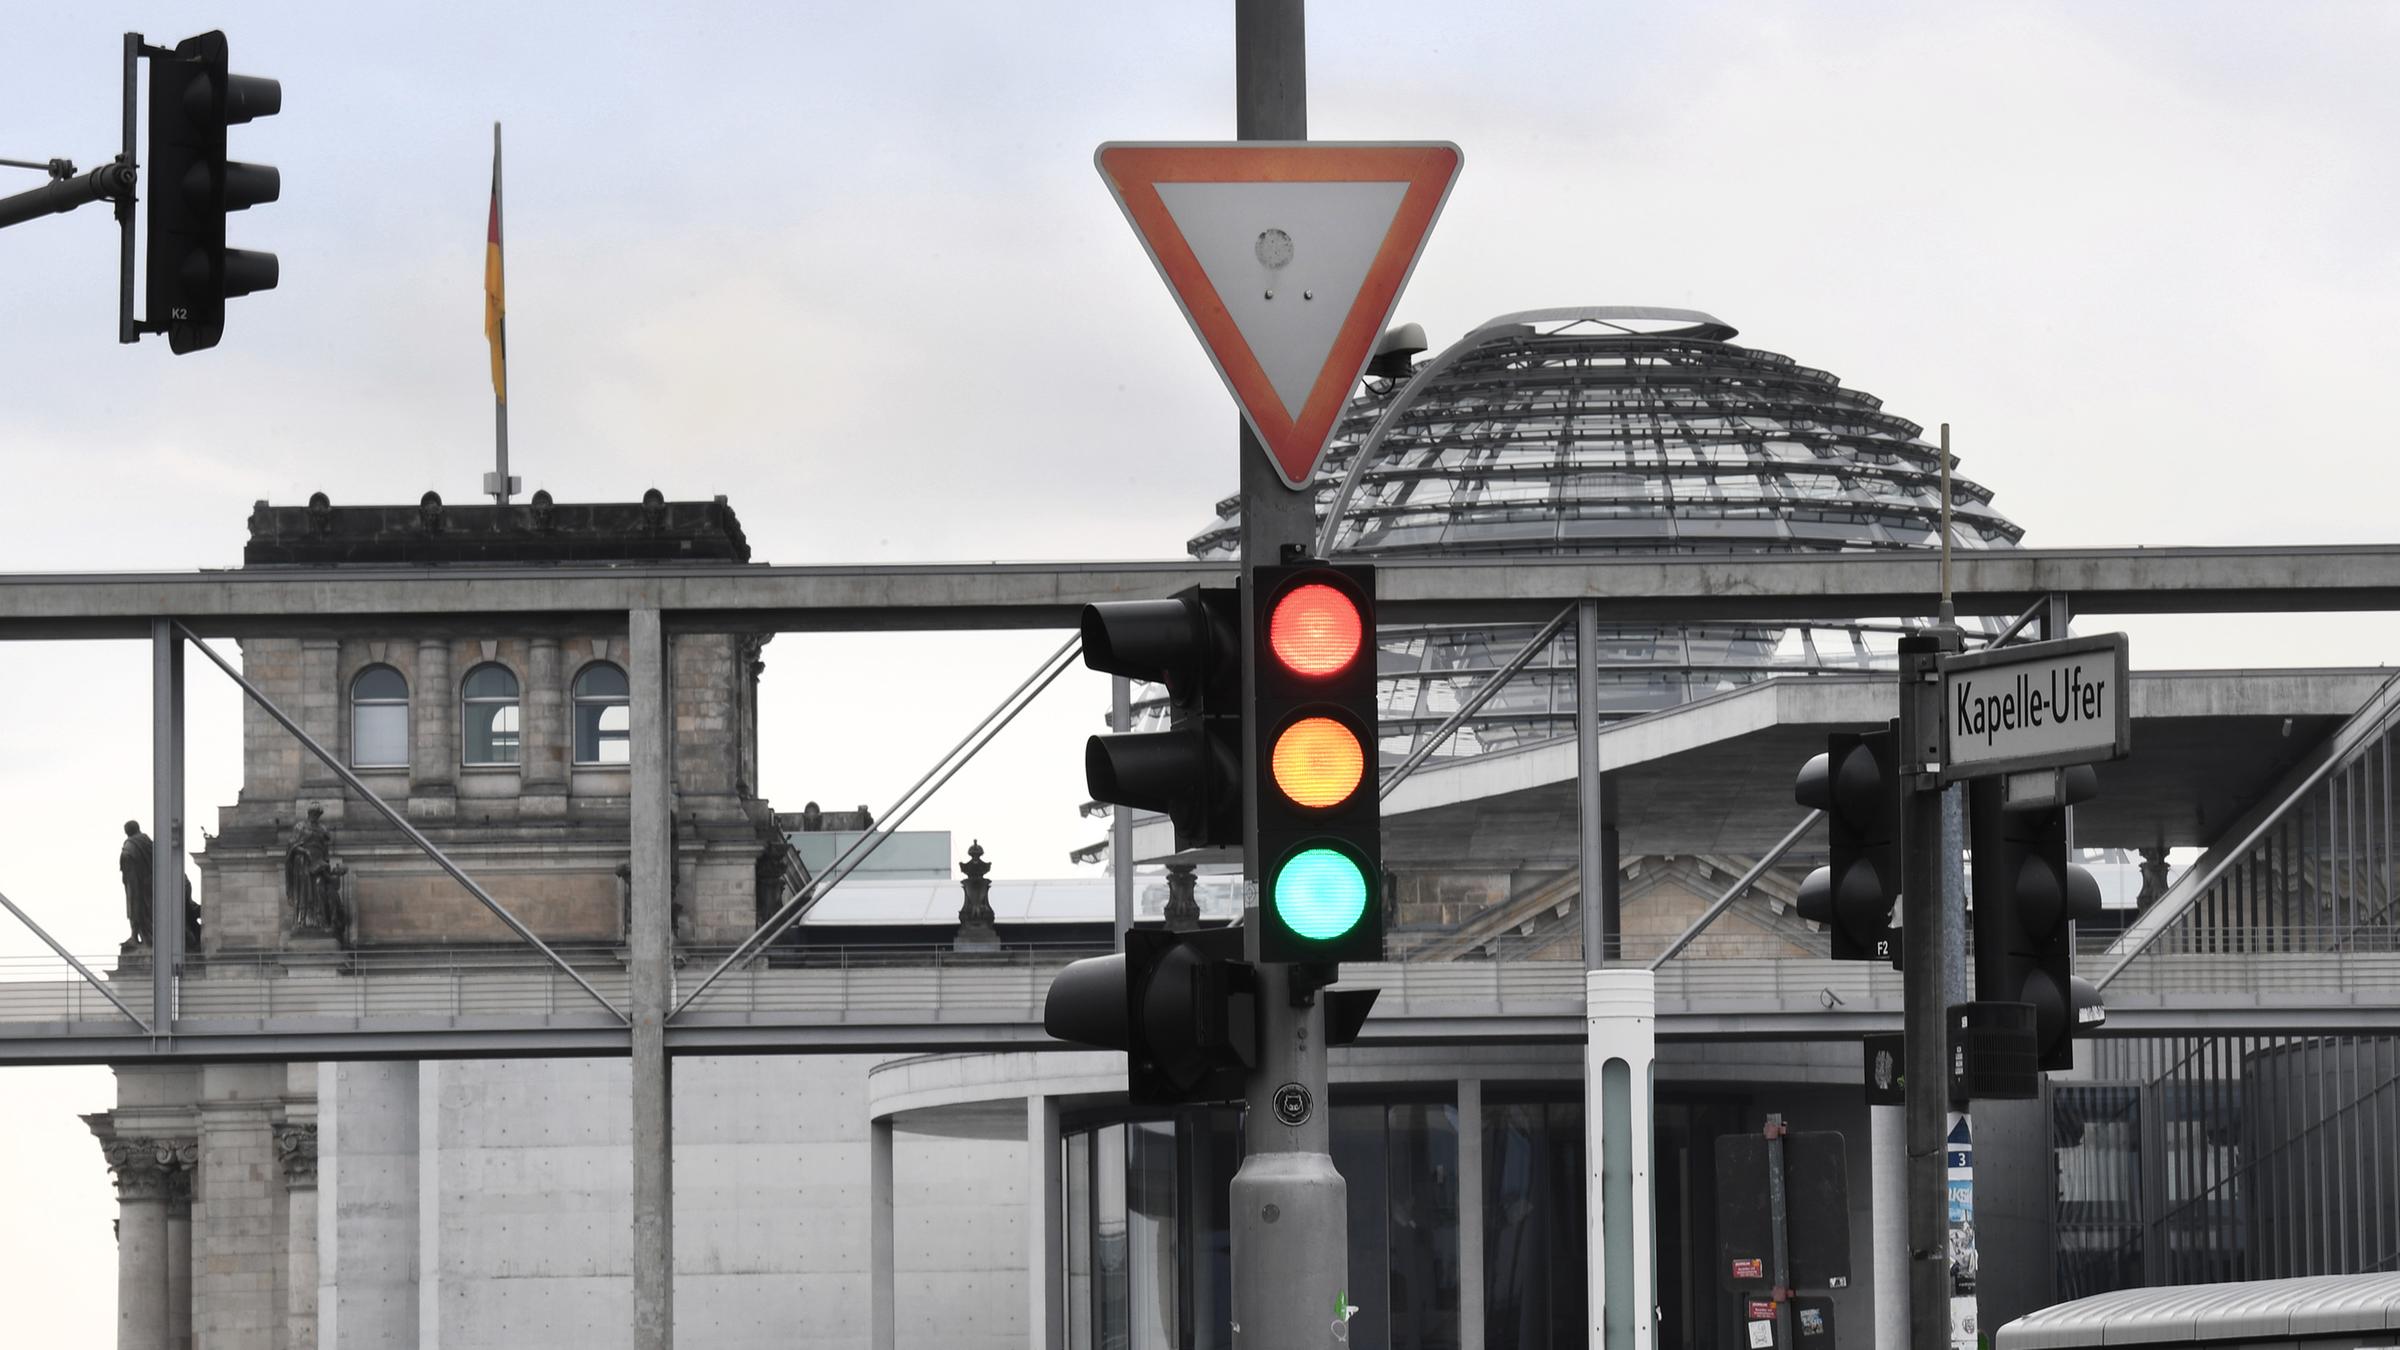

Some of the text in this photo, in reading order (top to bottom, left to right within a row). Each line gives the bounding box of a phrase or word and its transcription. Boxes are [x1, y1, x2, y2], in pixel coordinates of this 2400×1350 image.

[172, 307, 188, 319] K2
[1957, 665, 2105, 746] Kapelle-Ufer
[1877, 940, 1889, 956] F2
[1958, 1153, 1966, 1166] 3
